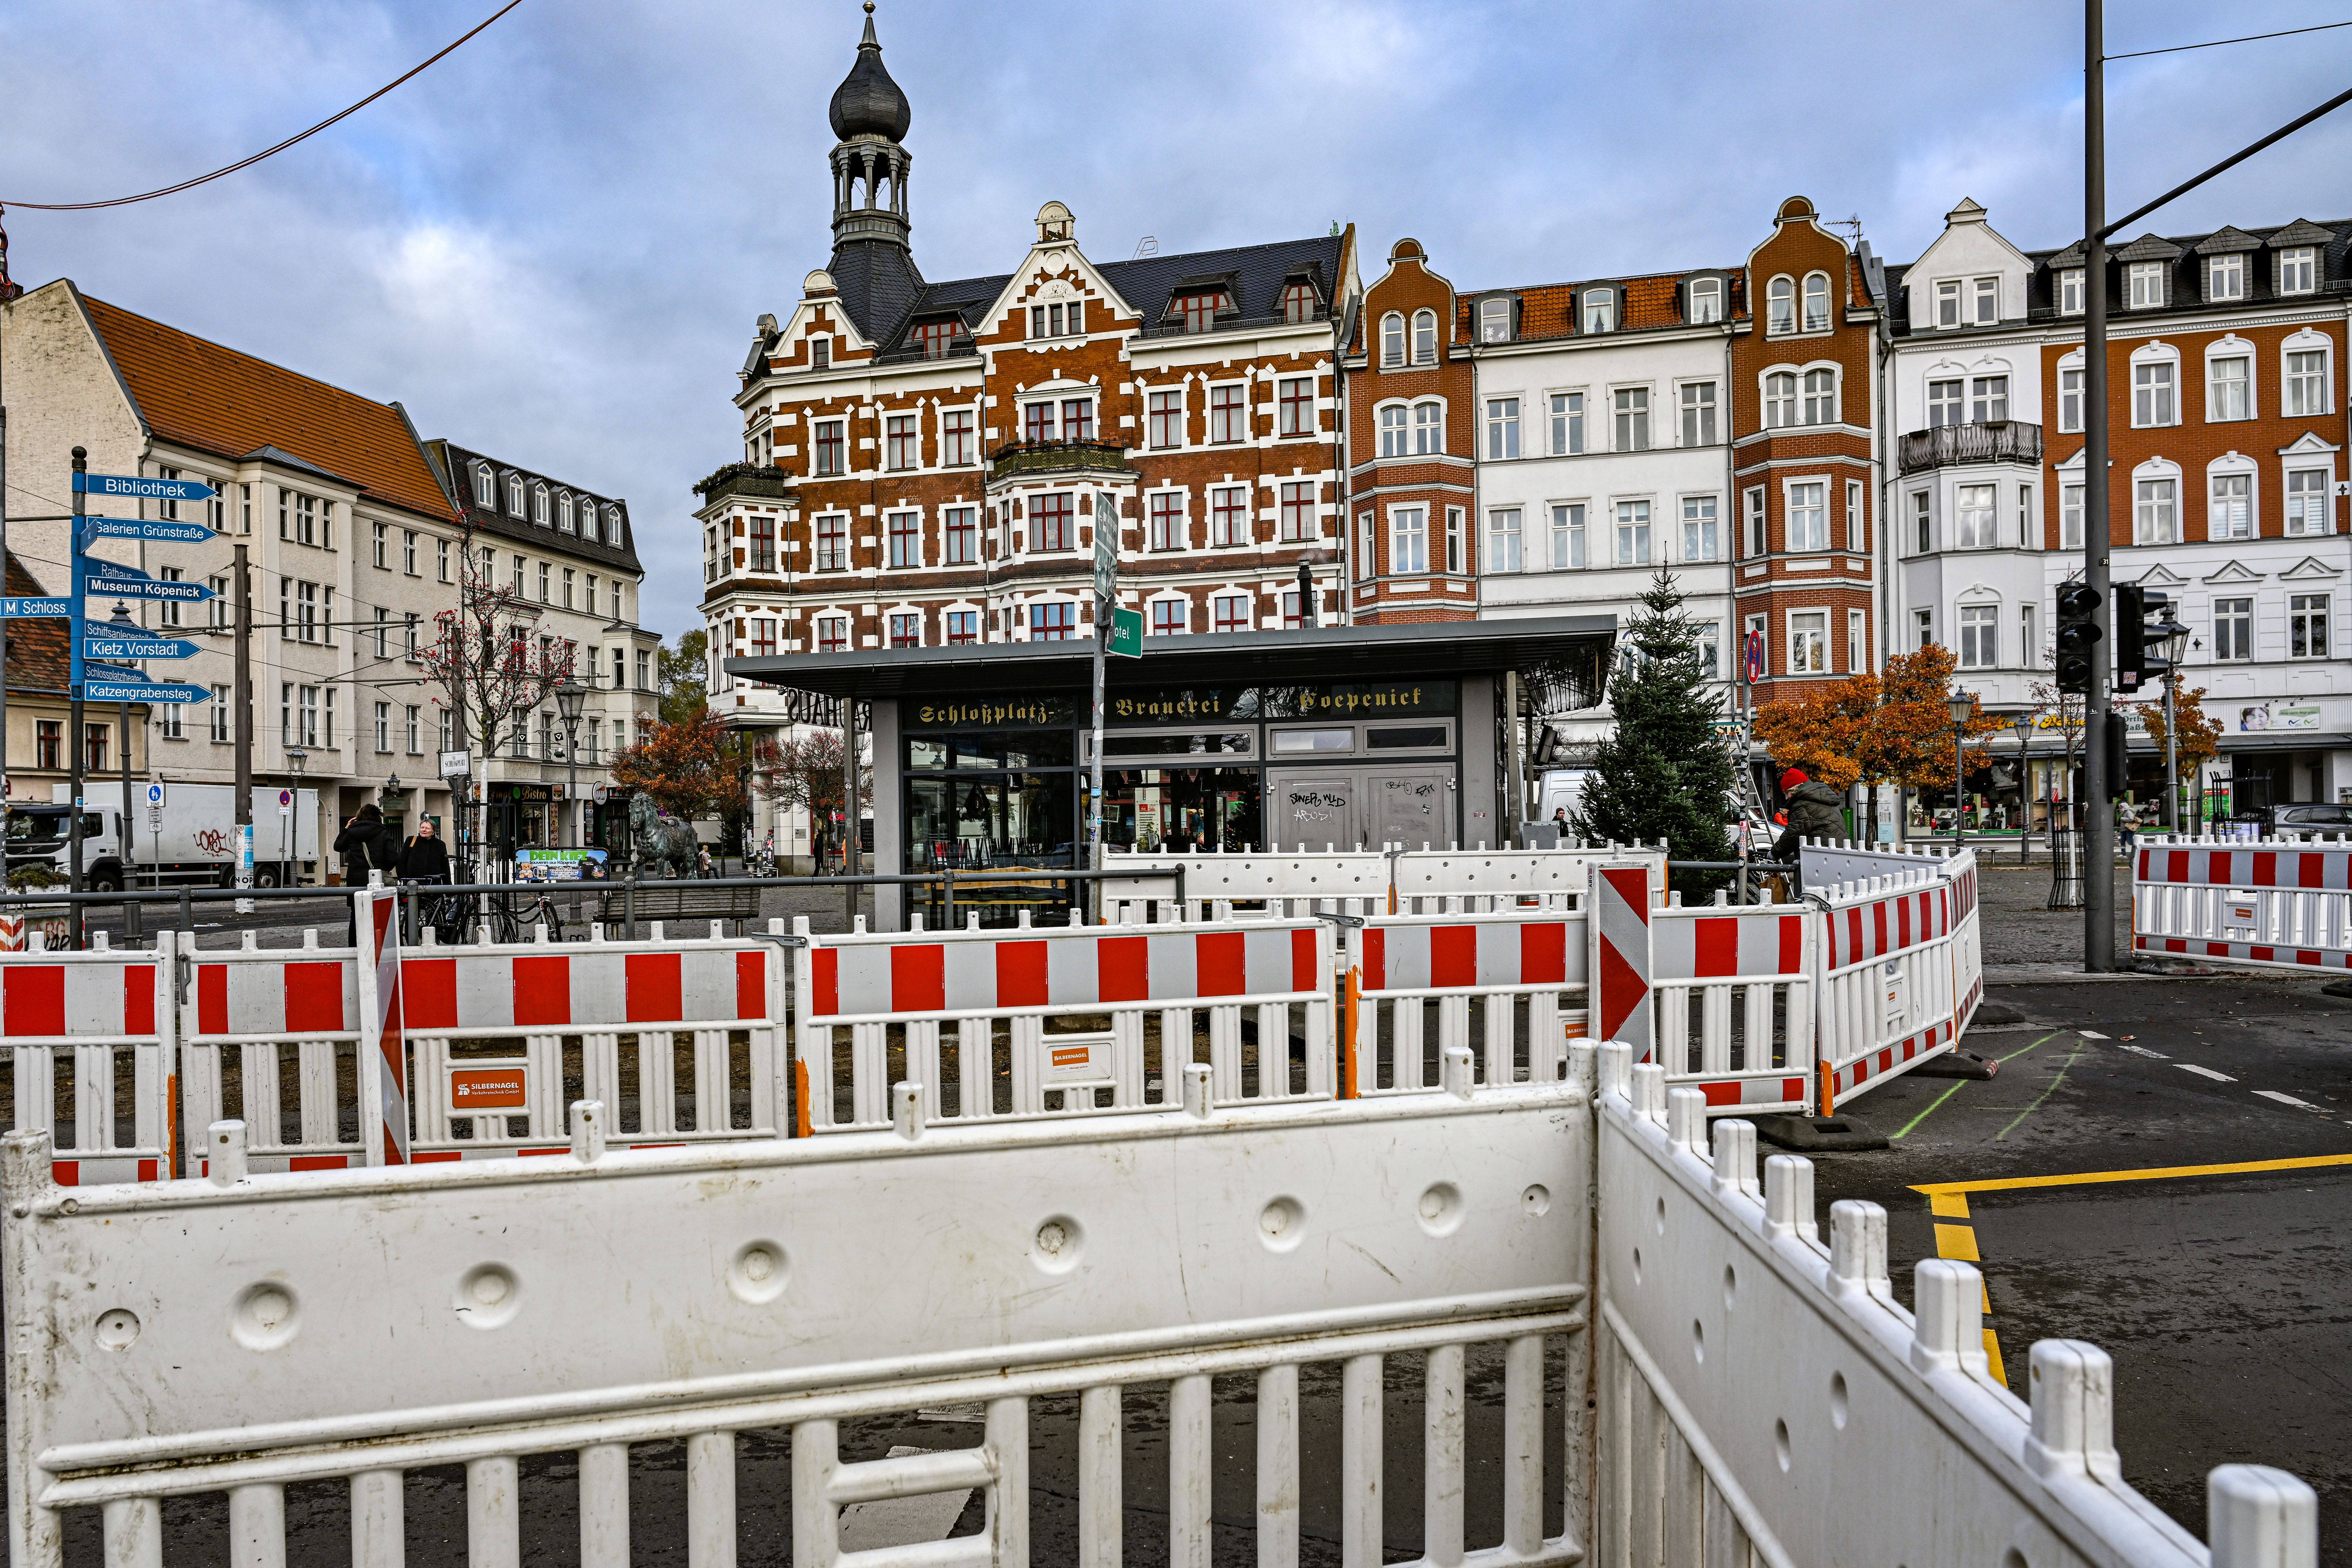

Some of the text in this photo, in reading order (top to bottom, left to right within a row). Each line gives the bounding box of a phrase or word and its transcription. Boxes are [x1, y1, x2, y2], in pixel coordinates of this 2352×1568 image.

[106, 479, 186, 497] Bibliothek
[98, 522, 203, 539] Galerien Grünstraße
[91, 579, 200, 597] Museum Köpenick
[23, 601, 66, 614] Schloss
[1115, 626, 1129, 639] otel
[93, 642, 178, 655] Kietz Vorstadt
[86, 666, 142, 682] Schlossplatztheater
[90, 685, 192, 702] Katzengrabensteg
[920, 688, 1421, 726] Schloßplatz- Brauerei Coepenick
[521, 786, 546, 800] Bistro
[530, 851, 588, 860] DEIN KIEZ
